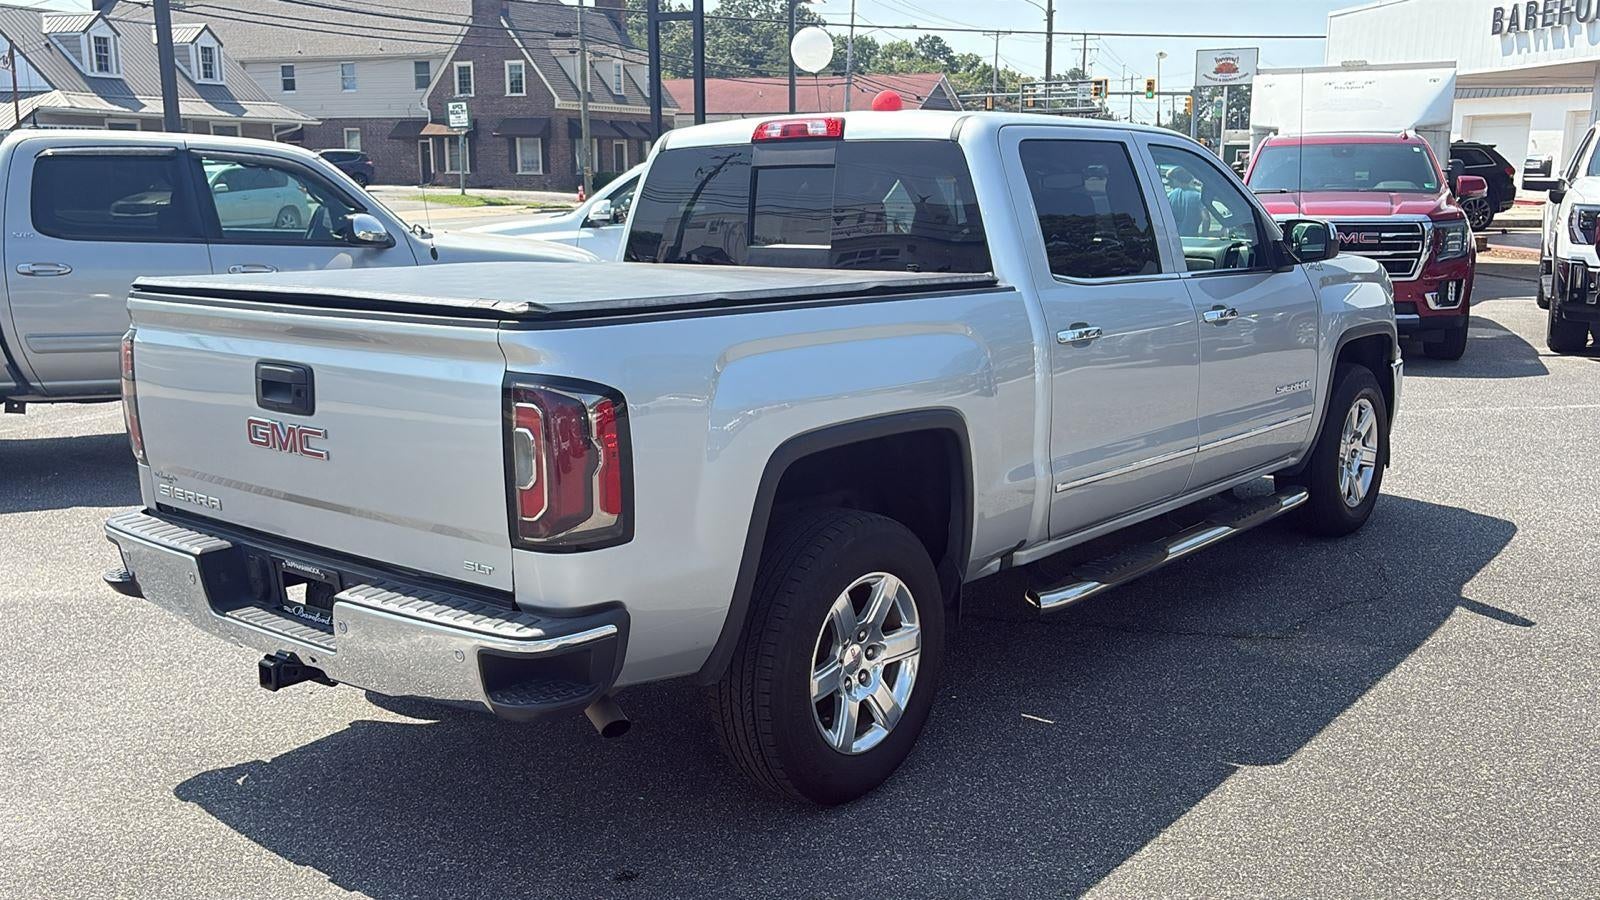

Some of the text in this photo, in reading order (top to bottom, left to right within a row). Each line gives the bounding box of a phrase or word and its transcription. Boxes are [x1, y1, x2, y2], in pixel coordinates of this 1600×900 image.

[1491, 0, 1600, 35] BAREFO
[1337, 231, 1379, 244] MC
[246, 416, 329, 460] GMC
[159, 483, 222, 511] SIERRA
[463, 560, 495, 575] SLT
